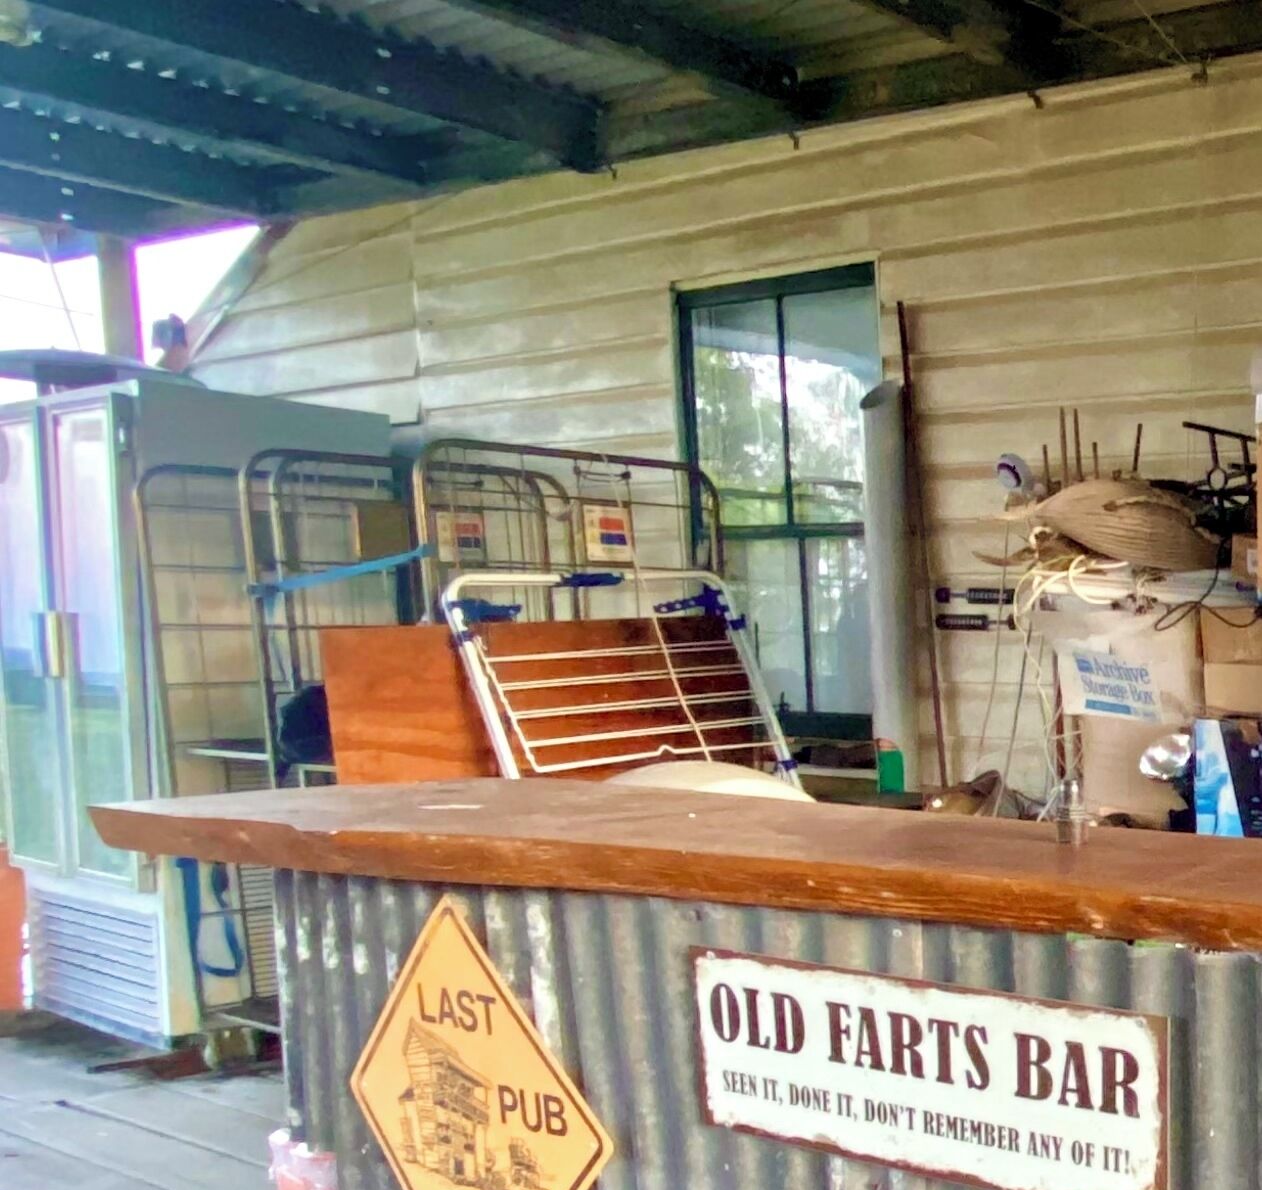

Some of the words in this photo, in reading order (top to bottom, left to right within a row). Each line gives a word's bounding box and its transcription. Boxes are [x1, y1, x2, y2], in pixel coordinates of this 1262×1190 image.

[1080, 675, 1128, 699] Storage
[1128, 682, 1156, 705] Box
[1093, 657, 1151, 685] Archive
[417, 983, 496, 1036] LAST
[710, 982, 806, 1055] OLD
[826, 1001, 990, 1091] FARTS
[1013, 1032, 1141, 1119] BAR
[497, 1085, 568, 1137] PUB
[723, 1070, 758, 1097] SEEN
[763, 1077, 783, 1106] IT,
[789, 1083, 832, 1113] DONE
[837, 1093, 858, 1122] IT,
[864, 1098, 917, 1131] DON'T
[923, 1110, 1020, 1153] REMEMBER
[1027, 1130, 1063, 1161] ANY
[1071, 1139, 1095, 1167] OF
[1103, 1146, 1130, 1175] IT!
